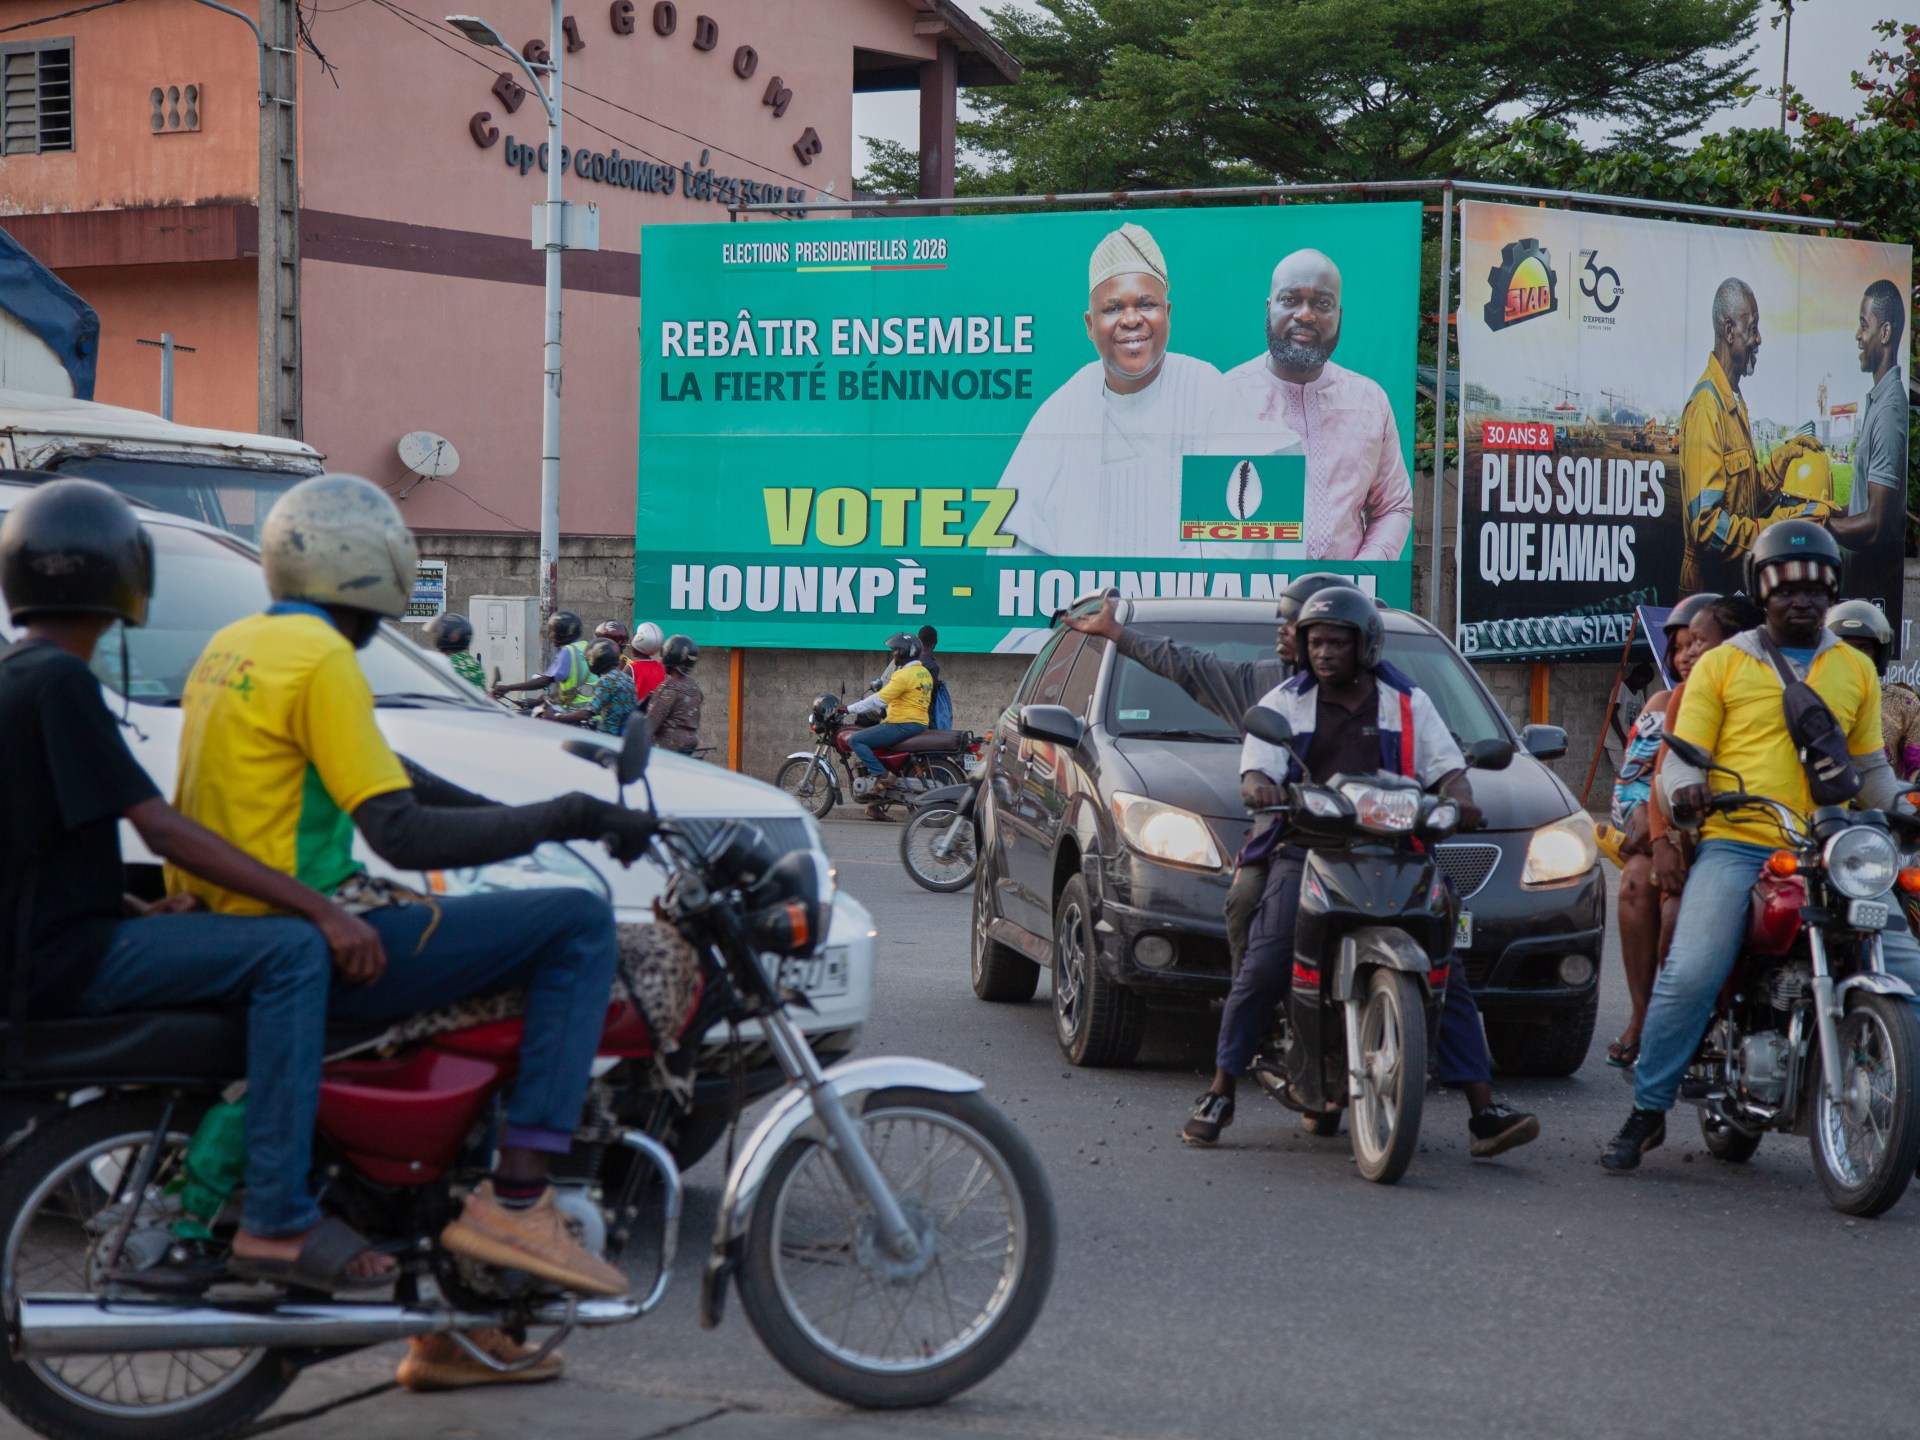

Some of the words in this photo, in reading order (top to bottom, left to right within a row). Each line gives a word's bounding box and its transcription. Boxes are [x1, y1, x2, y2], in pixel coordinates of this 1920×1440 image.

[505, 135, 536, 176] bp
[723, 243, 790, 264] ELECTIONS
[795, 240, 907, 263] PRESIDENTIELLES
[912, 238, 948, 260] 2026
[1506, 286, 1550, 316] SIAB
[1583, 315, 1616, 325] D'EXPERTISE
[661, 309, 820, 358] REBÂTIR
[831, 315, 1034, 356] ENSEMBLE
[660, 371, 702, 402] LA
[714, 361, 827, 402] FIERTÉ
[838, 360, 1033, 401] BÉNINOISE
[1487, 426, 1504, 444] 30
[1506, 427, 1536, 445] ANS
[1538, 428, 1549, 446] &
[1481, 453, 1553, 514] PLUS
[1556, 456, 1666, 518] SOLIDES
[763, 487, 1017, 548] VOTEZ
[1183, 525, 1300, 540] FCBE
[1479, 521, 1536, 587] QUE
[1537, 523, 1636, 583] JAMAIS
[670, 558, 927, 615] HOUNKPÈ
